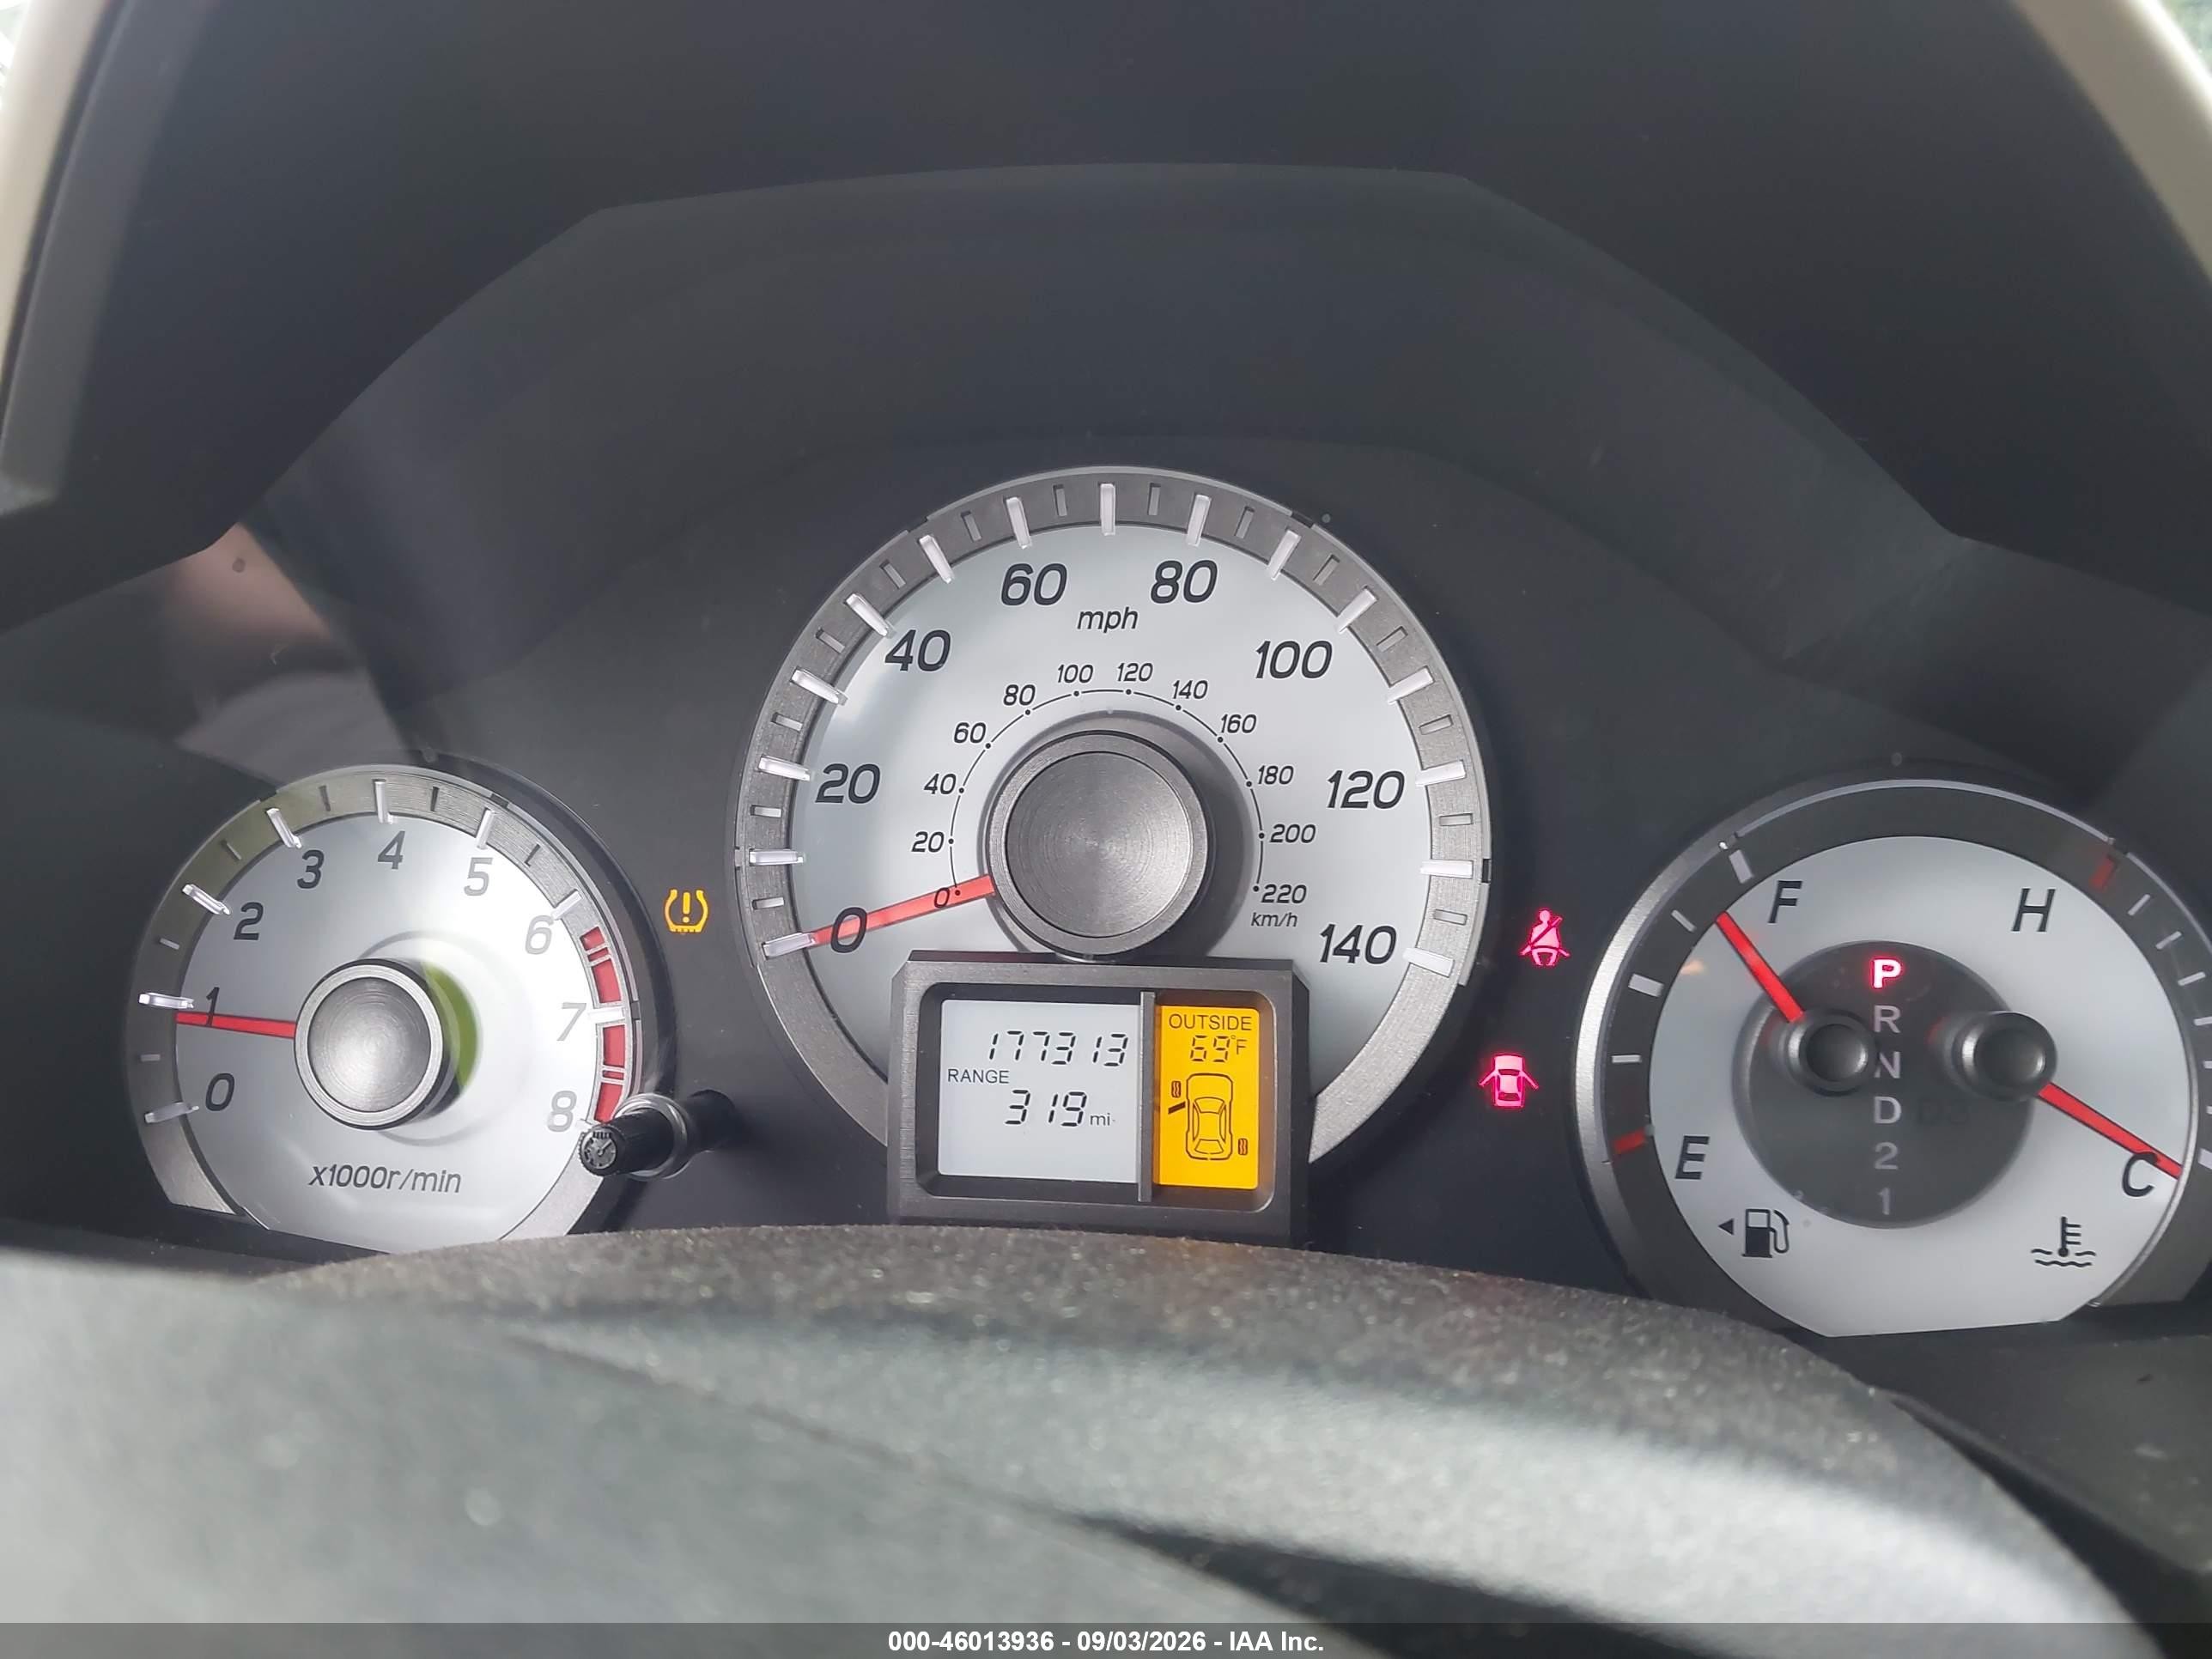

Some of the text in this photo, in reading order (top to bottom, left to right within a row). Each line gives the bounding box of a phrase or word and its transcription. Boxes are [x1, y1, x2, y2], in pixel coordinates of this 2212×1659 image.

[1000, 562, 1066, 605] 60
[1150, 559, 1218, 602] 80
[1077, 606, 1138, 633] mph
[884, 629, 951, 671] 40
[1255, 640, 1332, 678] 100
[1056, 664, 1094, 683] 100
[1116, 662, 1153, 682] 120
[1172, 679, 1208, 699] 140
[1002, 684, 1036, 705] 80
[953, 722, 986, 743] 60
[1220, 714, 1256, 732] 160
[815, 763, 880, 803] 20
[923, 773, 956, 794] 40
[1257, 764, 1293, 784] 180
[1327, 769, 1404, 808] 120
[377, 830, 404, 869] 4
[911, 830, 944, 852] 20
[1269, 823, 1316, 842] 200
[296, 848, 324, 889] 3
[464, 856, 492, 896] 5
[933, 886, 950, 908] 0
[1260, 884, 1306, 902] 220
[1767, 879, 1802, 922] F
[2011, 887, 2055, 932] H
[233, 902, 264, 939] 2
[524, 914, 553, 955] 6
[830, 906, 867, 952] 0
[1250, 911, 1297, 927] km/h
[1319, 923, 1395, 963] 140
[1871, 957, 1901, 988] P
[203, 986, 220, 1025] 1
[555, 1001, 586, 1042] 7
[1169, 1013, 1252, 1031] OUTSIDE
[1872, 1003, 1900, 1034] R
[988, 1030, 1129, 1067] 177313
[1873, 1050, 1900, 1078] N
[204, 1072, 234, 1111] 0
[947, 1068, 1011, 1085] RANGE
[544, 1089, 576, 1133] 8
[1004, 1089, 1088, 1127] 319
[1873, 1095, 1901, 1123] D
[1674, 1133, 1709, 1180] E
[1873, 1140, 1898, 1170] 2
[307, 1162, 462, 1194] x1000r/min
[2120, 1150, 2158, 1196] C
[1878, 1185, 1893, 1214] 1
